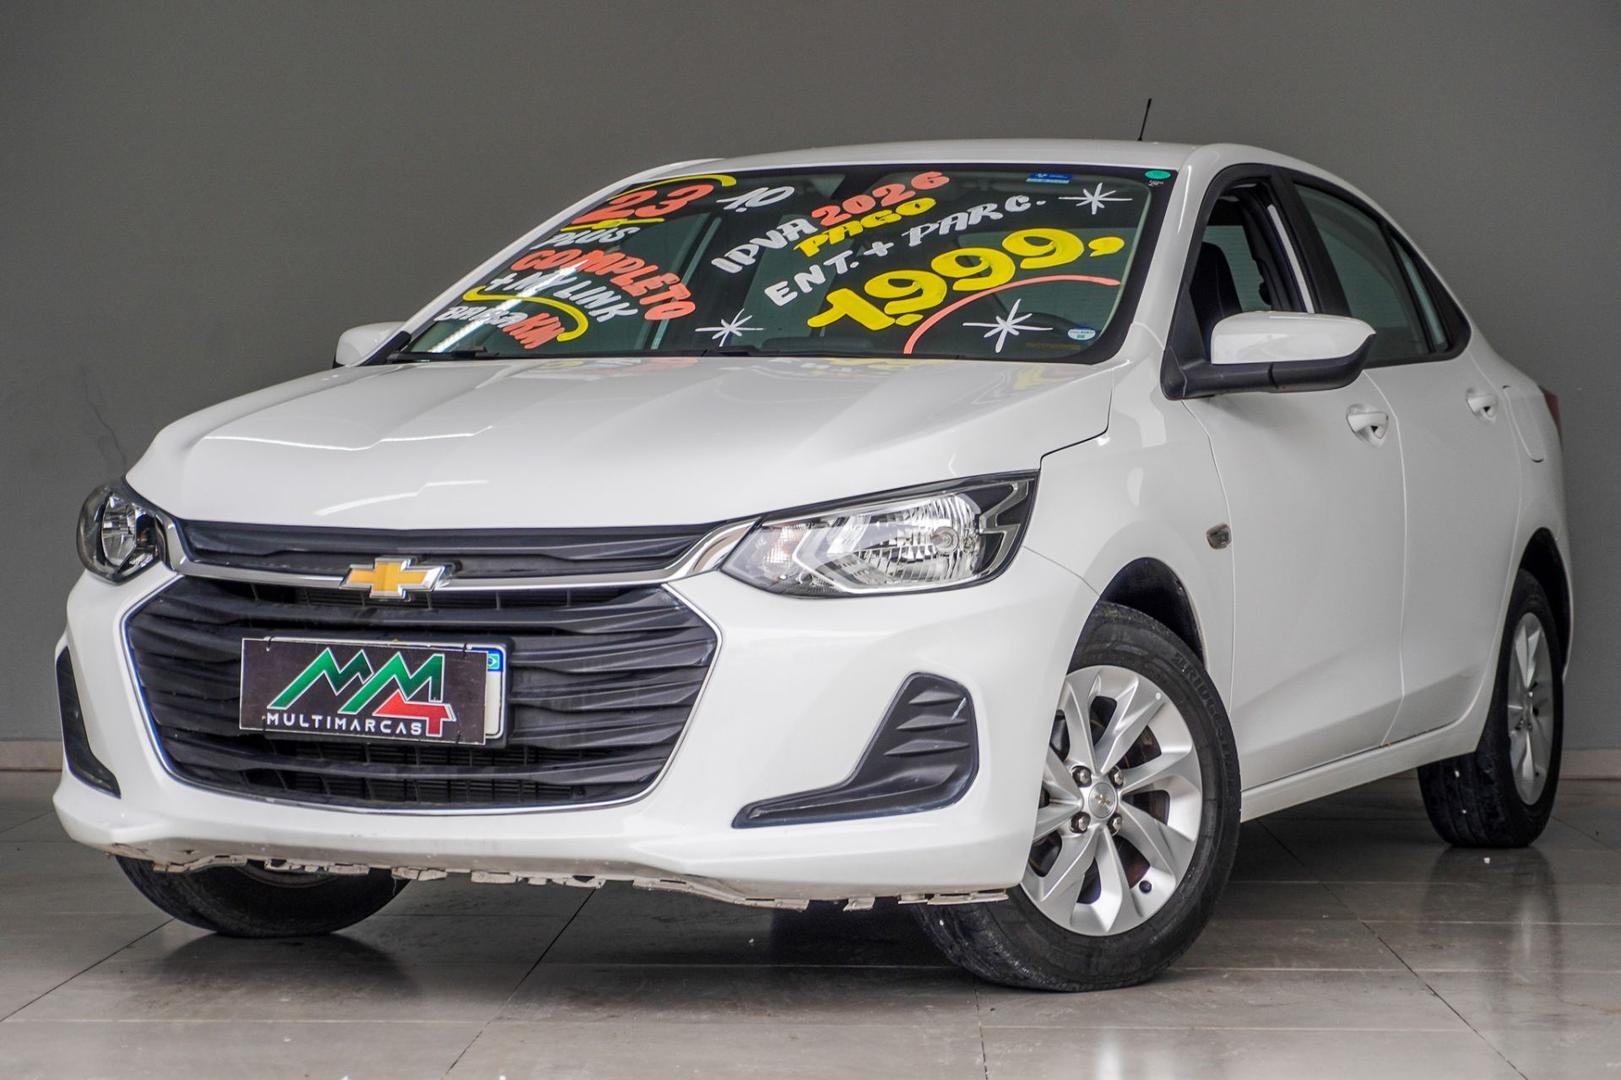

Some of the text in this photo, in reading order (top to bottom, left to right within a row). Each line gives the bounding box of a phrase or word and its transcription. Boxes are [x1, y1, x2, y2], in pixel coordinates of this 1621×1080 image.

[529, 226, 641, 250] PLUS
[711, 171, 951, 274] IPVA 2026
[794, 197, 937, 257] PAGO
[764, 250, 859, 306] ENT.
[901, 195, 1047, 247] PARC.
[511, 248, 696, 321] COMPLETO
[552, 280, 639, 323] LINK
[502, 312, 566, 349] KM
[265, 712, 423, 736] MULTIMARCAS
